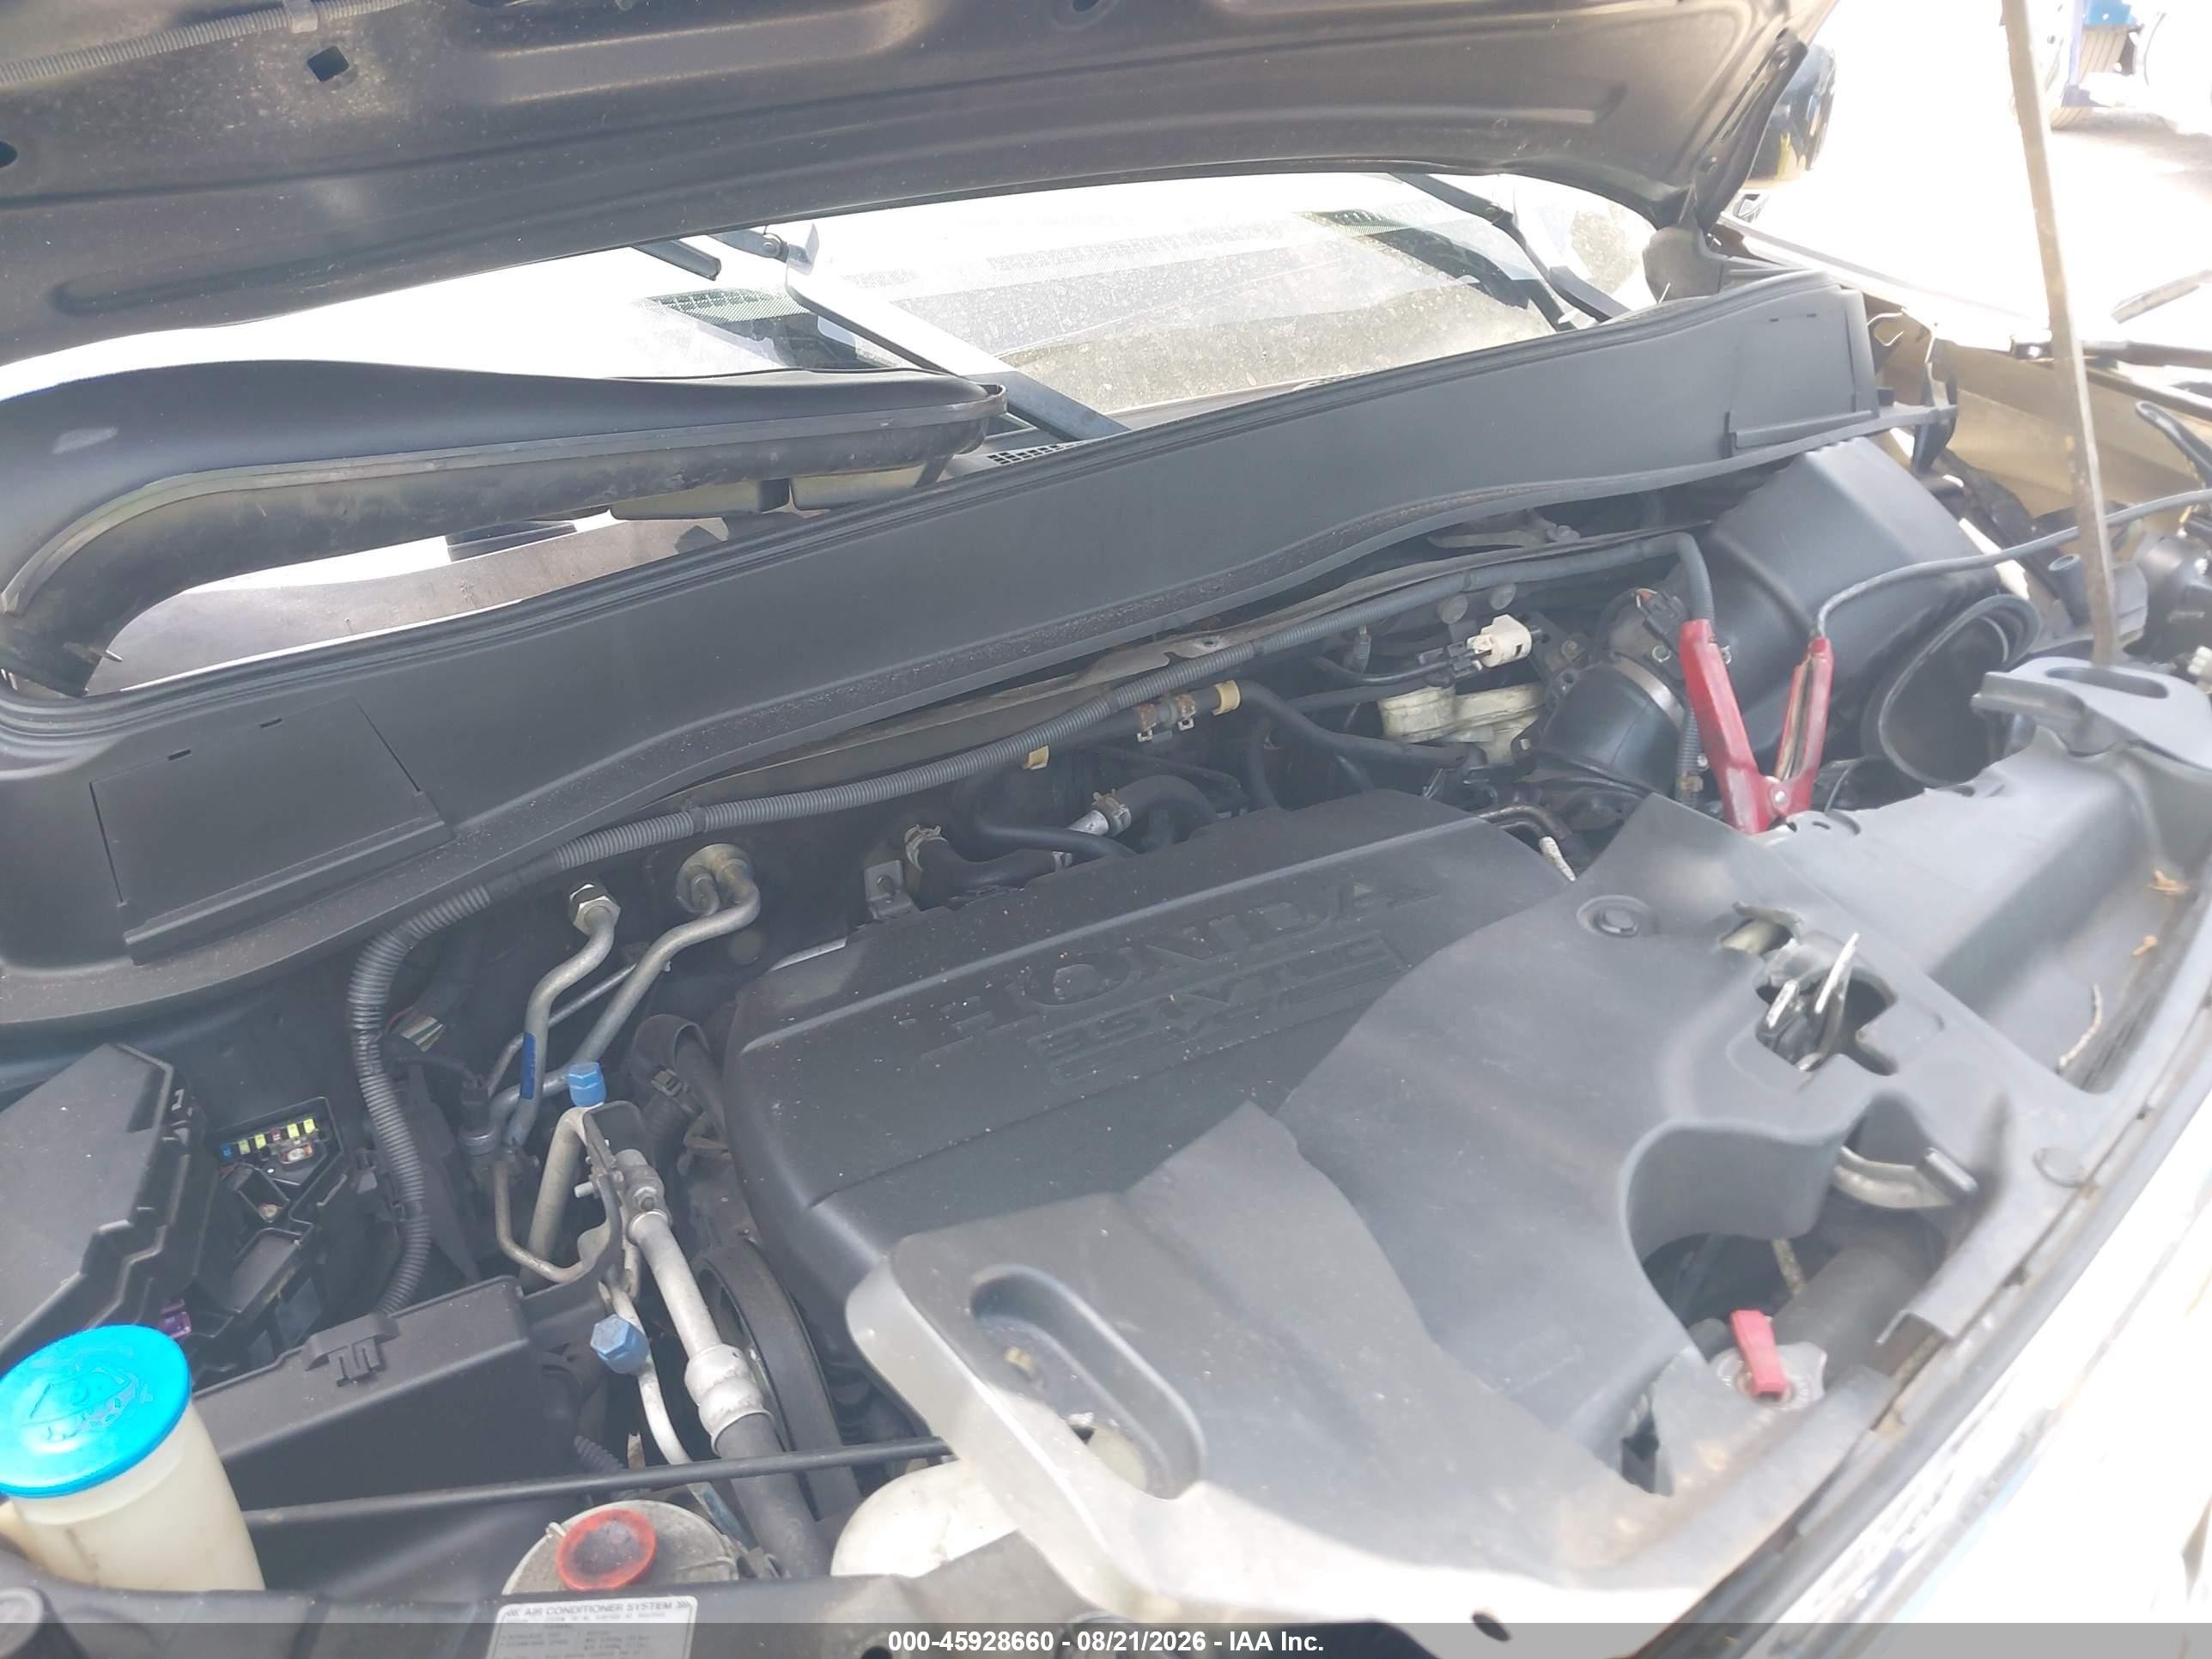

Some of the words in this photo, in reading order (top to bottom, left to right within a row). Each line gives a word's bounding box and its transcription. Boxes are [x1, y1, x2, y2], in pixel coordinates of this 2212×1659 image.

[525, 1607, 543, 1616] AIR
[546, 1603, 624, 1615] CONDITIONER
[626, 1601, 672, 1612] SYSTEM
